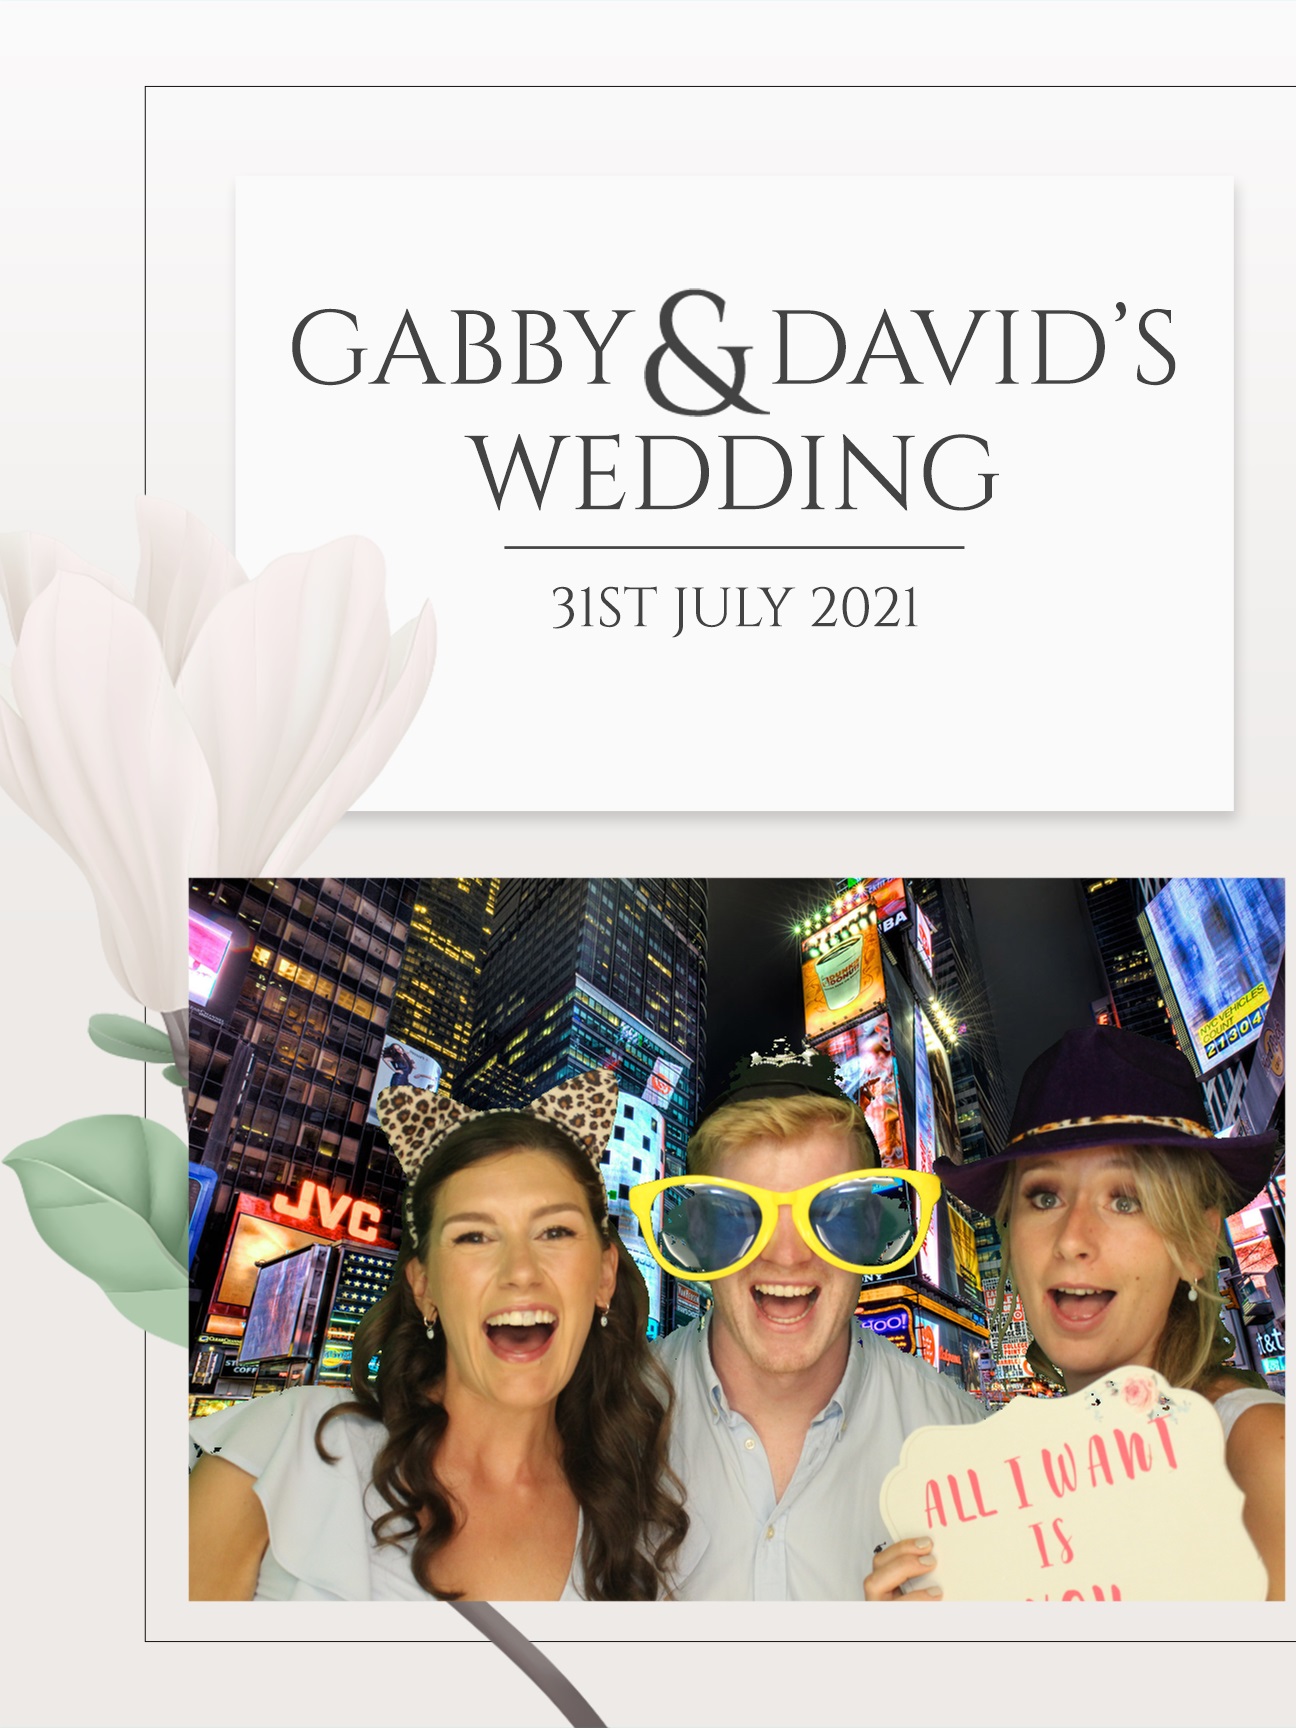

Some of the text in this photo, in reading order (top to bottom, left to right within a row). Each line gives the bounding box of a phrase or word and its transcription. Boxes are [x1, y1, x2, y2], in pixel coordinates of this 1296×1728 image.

[1200, 983, 1265, 1036] NYC VEHICLES
[1203, 1016, 1234, 1044] COUNT
[271, 1179, 382, 1243] JVC
[1256, 1328, 1285, 1355] t&t
[924, 1413, 1179, 1530] ALL I WANT
[1028, 1517, 1076, 1569] IS
